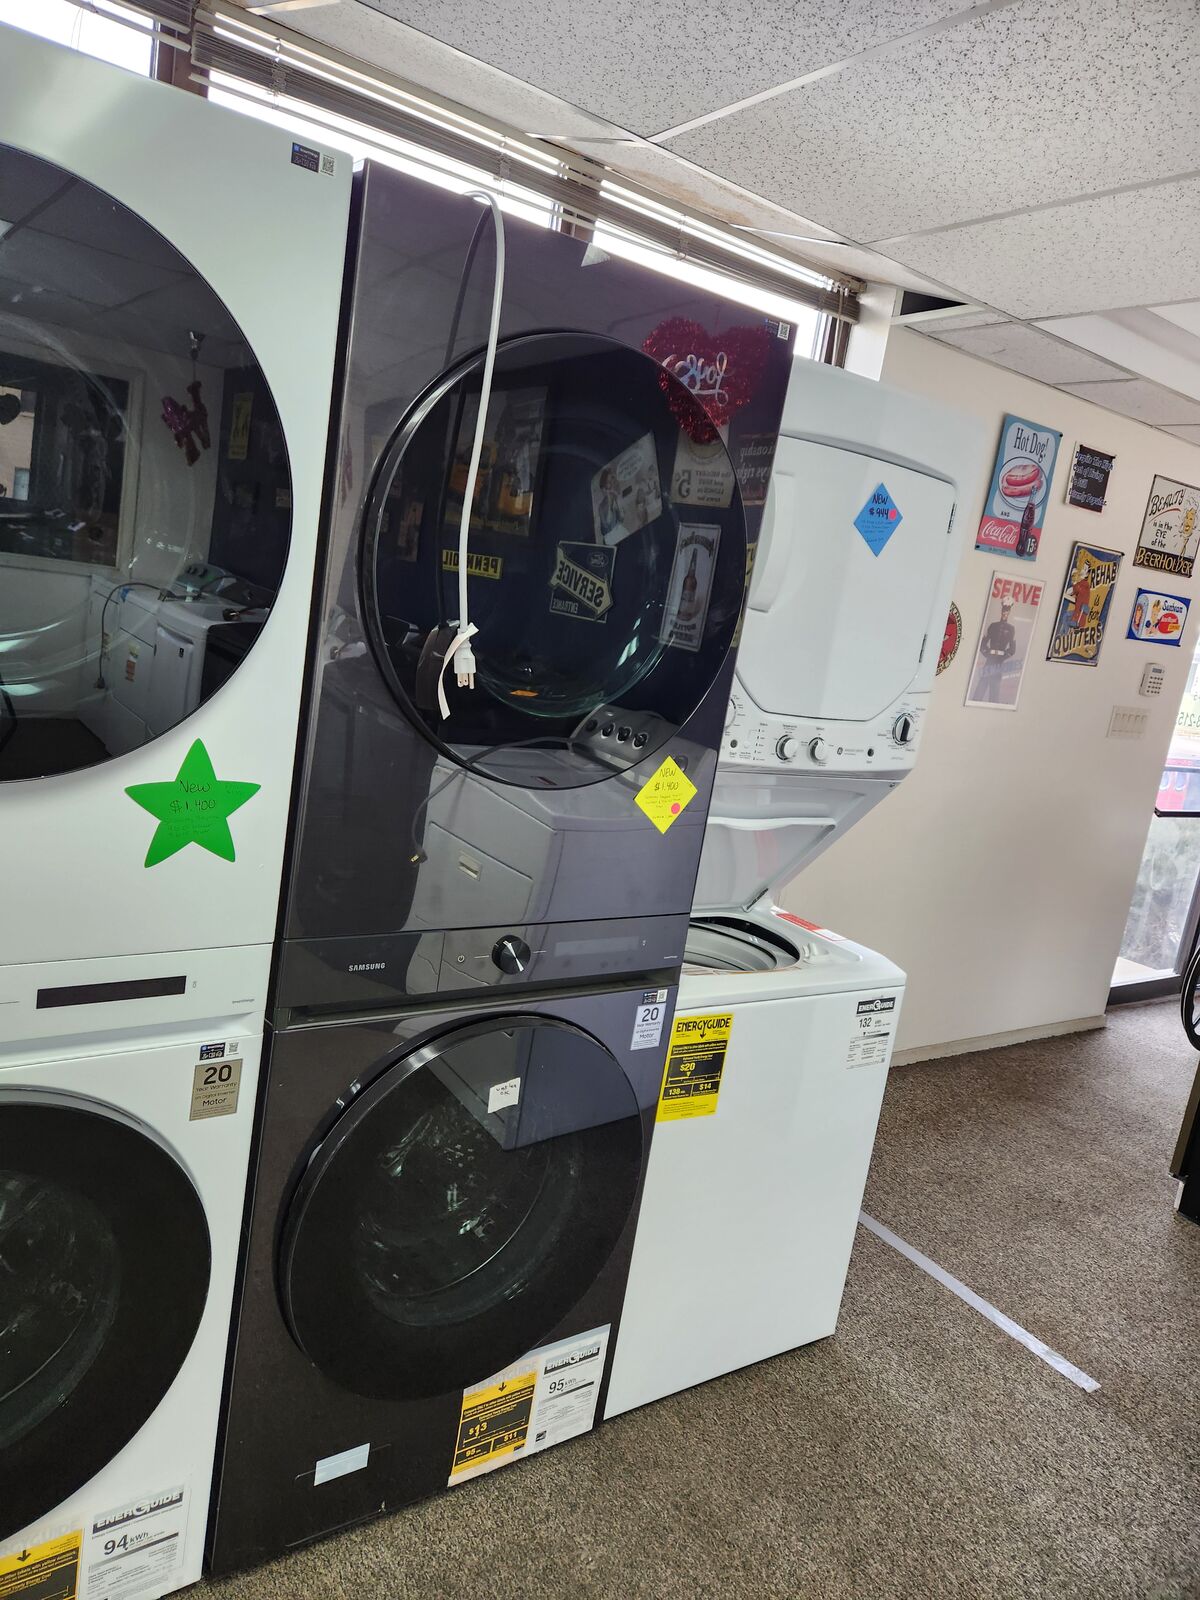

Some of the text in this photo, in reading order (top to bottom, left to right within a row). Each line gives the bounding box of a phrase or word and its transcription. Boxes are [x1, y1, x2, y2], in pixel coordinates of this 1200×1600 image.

[1013, 427, 1050, 463] Hot Dog!
[1148, 489, 1186, 517] BEAUTY
[1155, 529, 1167, 539] EYE
[1164, 521, 1173, 531] the
[1151, 538, 1167, 548] of the
[1136, 547, 1193, 577] BEERHOLDER
[1090, 562, 1117, 589] REHAB
[991, 578, 1042, 606] SERVE
[1053, 622, 1102, 655] QUITTERS
[348, 962, 386, 972] SAMSUNG
[641, 1007, 659, 1022] 20
[859, 1017, 872, 1028] 132
[676, 1017, 731, 1034] ENERGYGUIDE
[203, 1064, 232, 1085] 20
[680, 1062, 696, 1072] $20
[210, 1081, 238, 1090] Warranty
[699, 1082, 712, 1091] $14
[202, 1097, 227, 1107] Motor
[549, 1378, 565, 1395] 95
[468, 1422, 488, 1438] $13
[104, 1531, 149, 1556] 94 kWh
